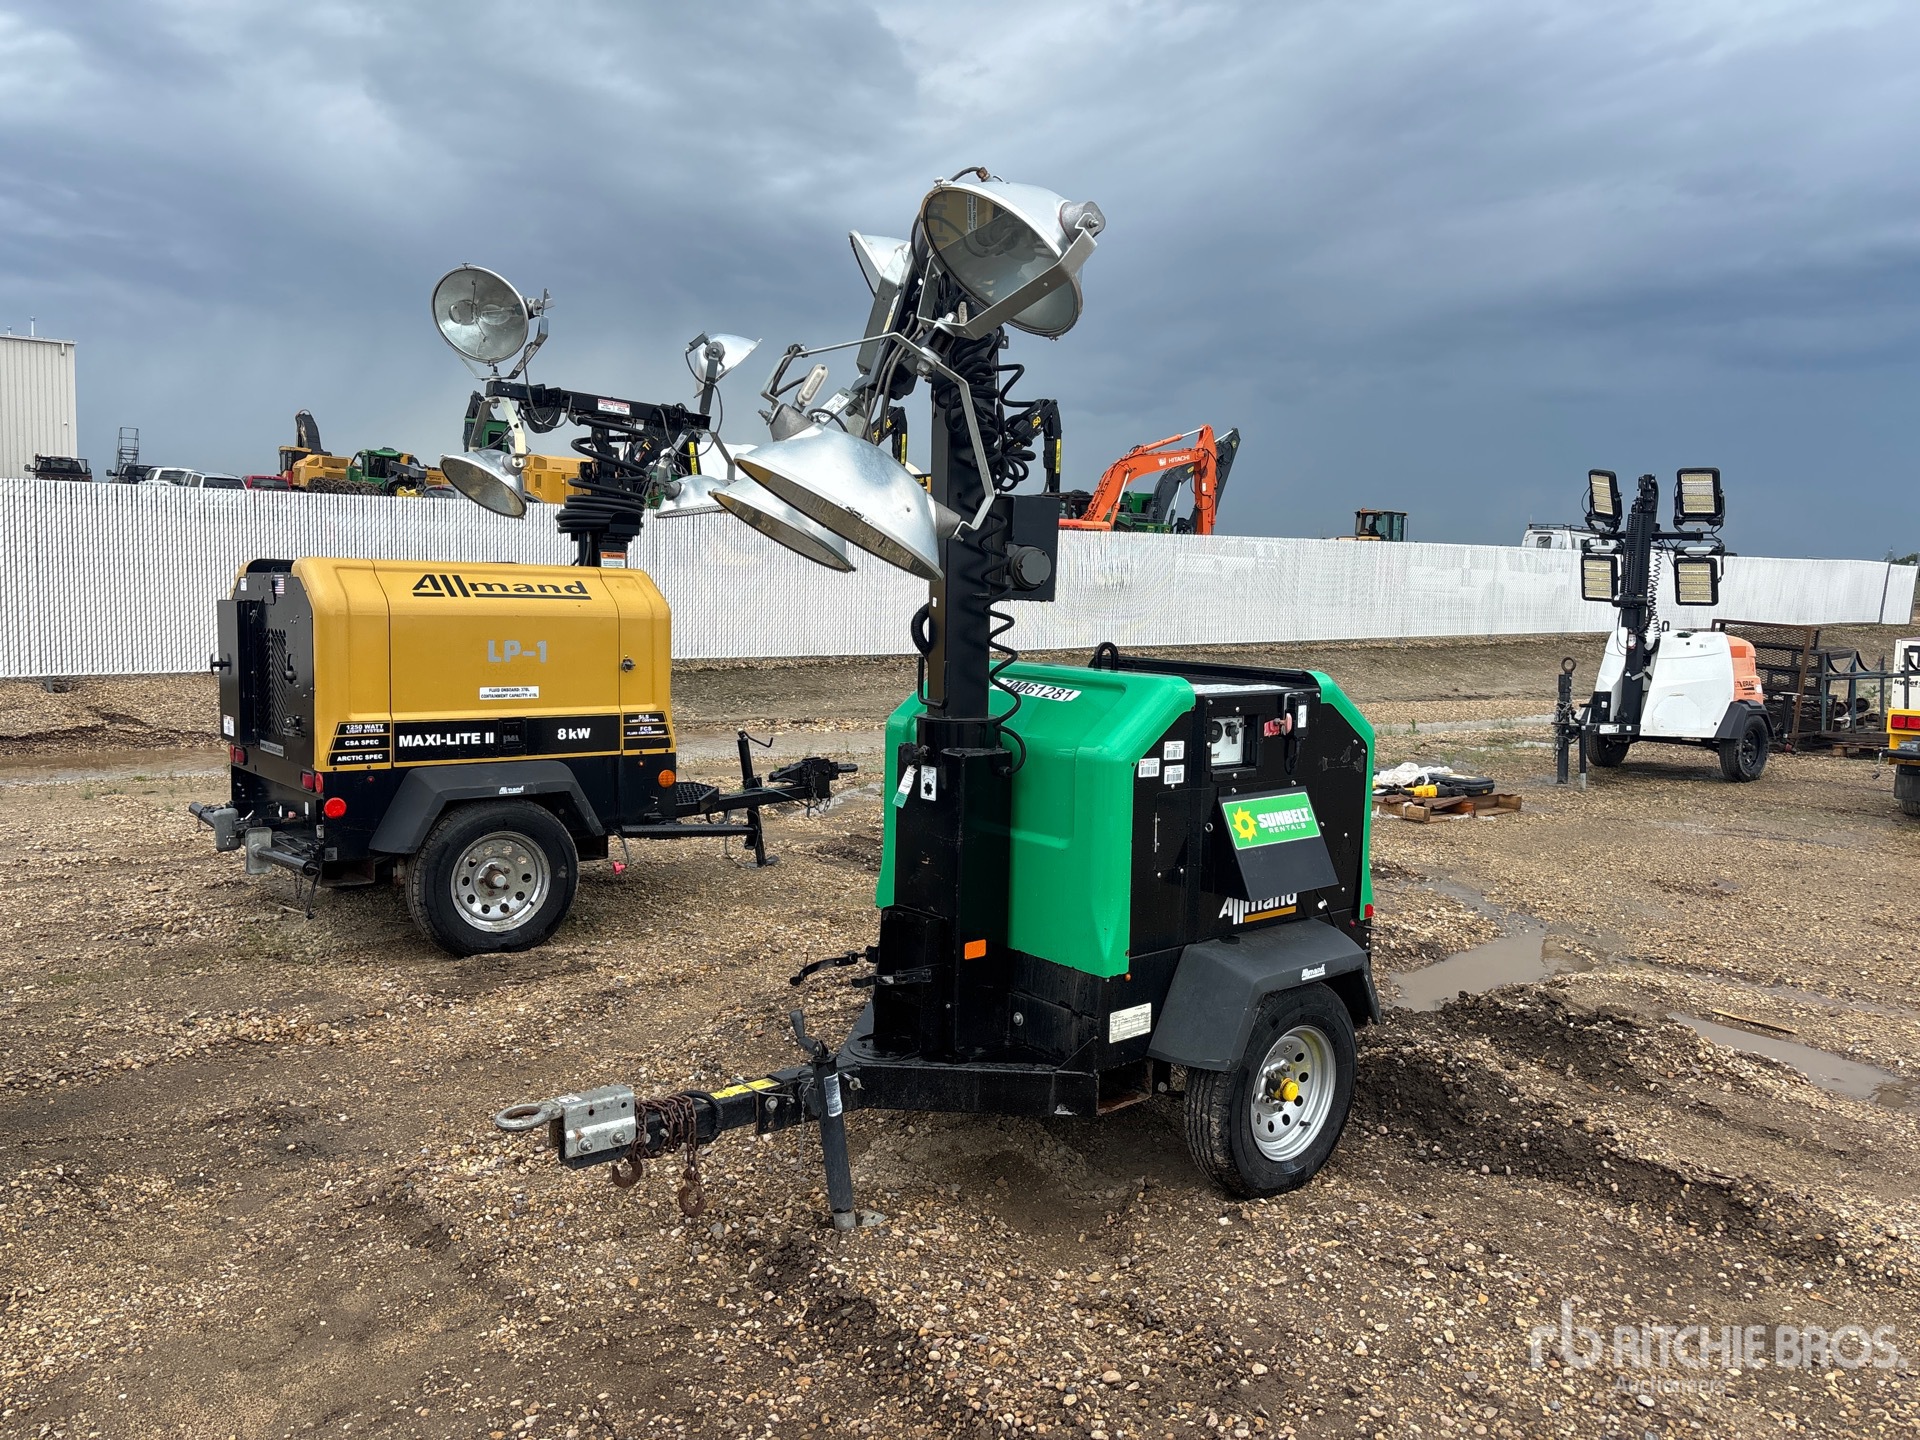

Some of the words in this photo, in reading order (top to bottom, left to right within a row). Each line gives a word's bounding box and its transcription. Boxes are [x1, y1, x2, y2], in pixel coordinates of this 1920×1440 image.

[1168, 455, 1190, 463] HITACHI
[412, 574, 591, 600] Allmand
[488, 640, 547, 663] LP-1
[398, 732, 481, 747] MAXI-LITE
[485, 732, 495, 744] II
[557, 728, 567, 740] 8
[568, 727, 591, 739] kW
[1256, 807, 1309, 828] SUNBELT
[1268, 823, 1307, 834] RENTALS
